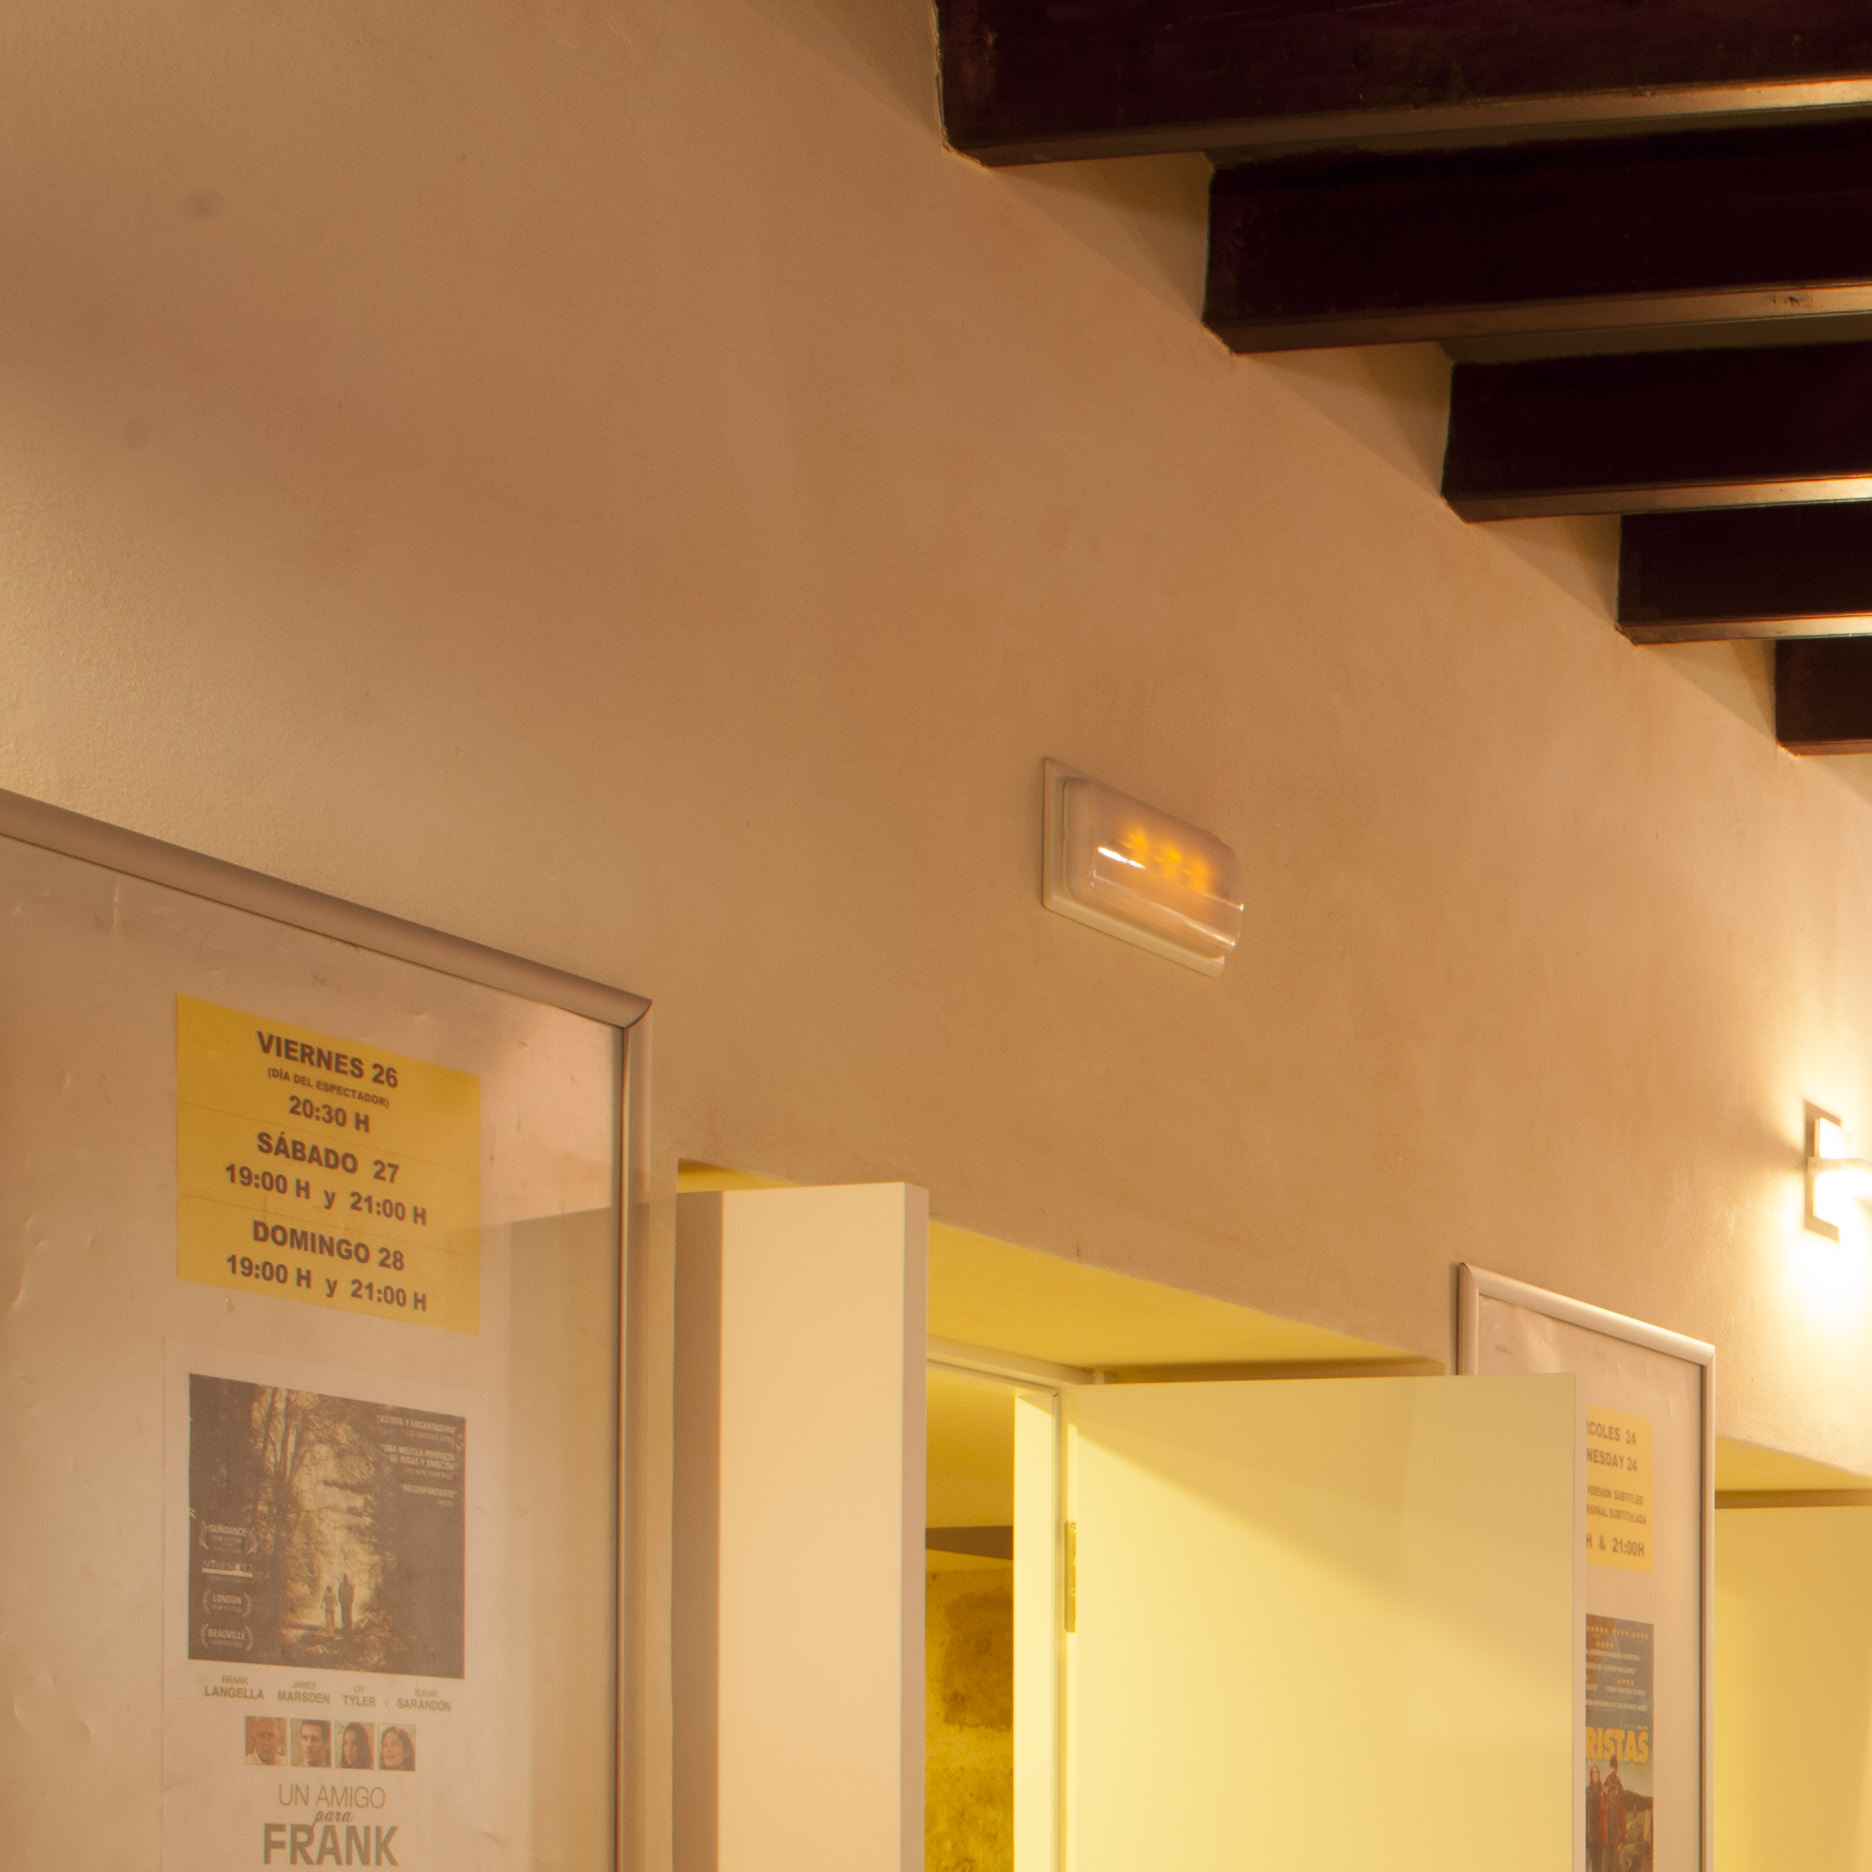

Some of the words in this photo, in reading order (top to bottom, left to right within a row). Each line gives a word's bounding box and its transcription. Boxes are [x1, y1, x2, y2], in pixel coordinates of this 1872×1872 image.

[257, 1031, 364, 1079] VIERNES
[372, 1064, 398, 1089] 26
[293, 1074, 313, 1088] DEL
[315, 1080, 390, 1109] ESPECTADOR)
[289, 1095, 346, 1126] 20:30
[355, 1112, 370, 1133] H
[257, 1131, 358, 1174] SÁBADO
[373, 1159, 399, 1183] 27
[225, 1163, 288, 1194] 19:00
[296, 1179, 310, 1199] H
[323, 1189, 336, 1209] y
[350, 1192, 406, 1222] 21:00
[412, 1206, 426, 1226] H
[253, 1220, 370, 1264] DOMINGO
[378, 1247, 404, 1271] 28
[226, 1255, 288, 1284] 19:00
[296, 1268, 311, 1289] H
[325, 1275, 337, 1298] y
[350, 1279, 406, 1307] 21:00
[413, 1291, 426, 1311] H
[1586, 1420, 1620, 1442] COLES
[1626, 1430, 1636, 1445] 24
[1586, 1448, 1624, 1470] NESDAY
[1627, 1457, 1637, 1472] 24
[1612, 1538, 1644, 1557] 21:00H
[204, 1686, 264, 1700] LANGELLA
[278, 1690, 330, 1704] MARSDEN
[343, 1695, 376, 1707] TYLER
[396, 1698, 451, 1712] SARANDON
[1586, 1726, 1649, 1763] RISTAS
[278, 1783, 309, 1806] UN
[315, 1785, 386, 1809] AMIGO
[311, 1809, 353, 1831] para
[263, 1823, 399, 1866] FRANK
